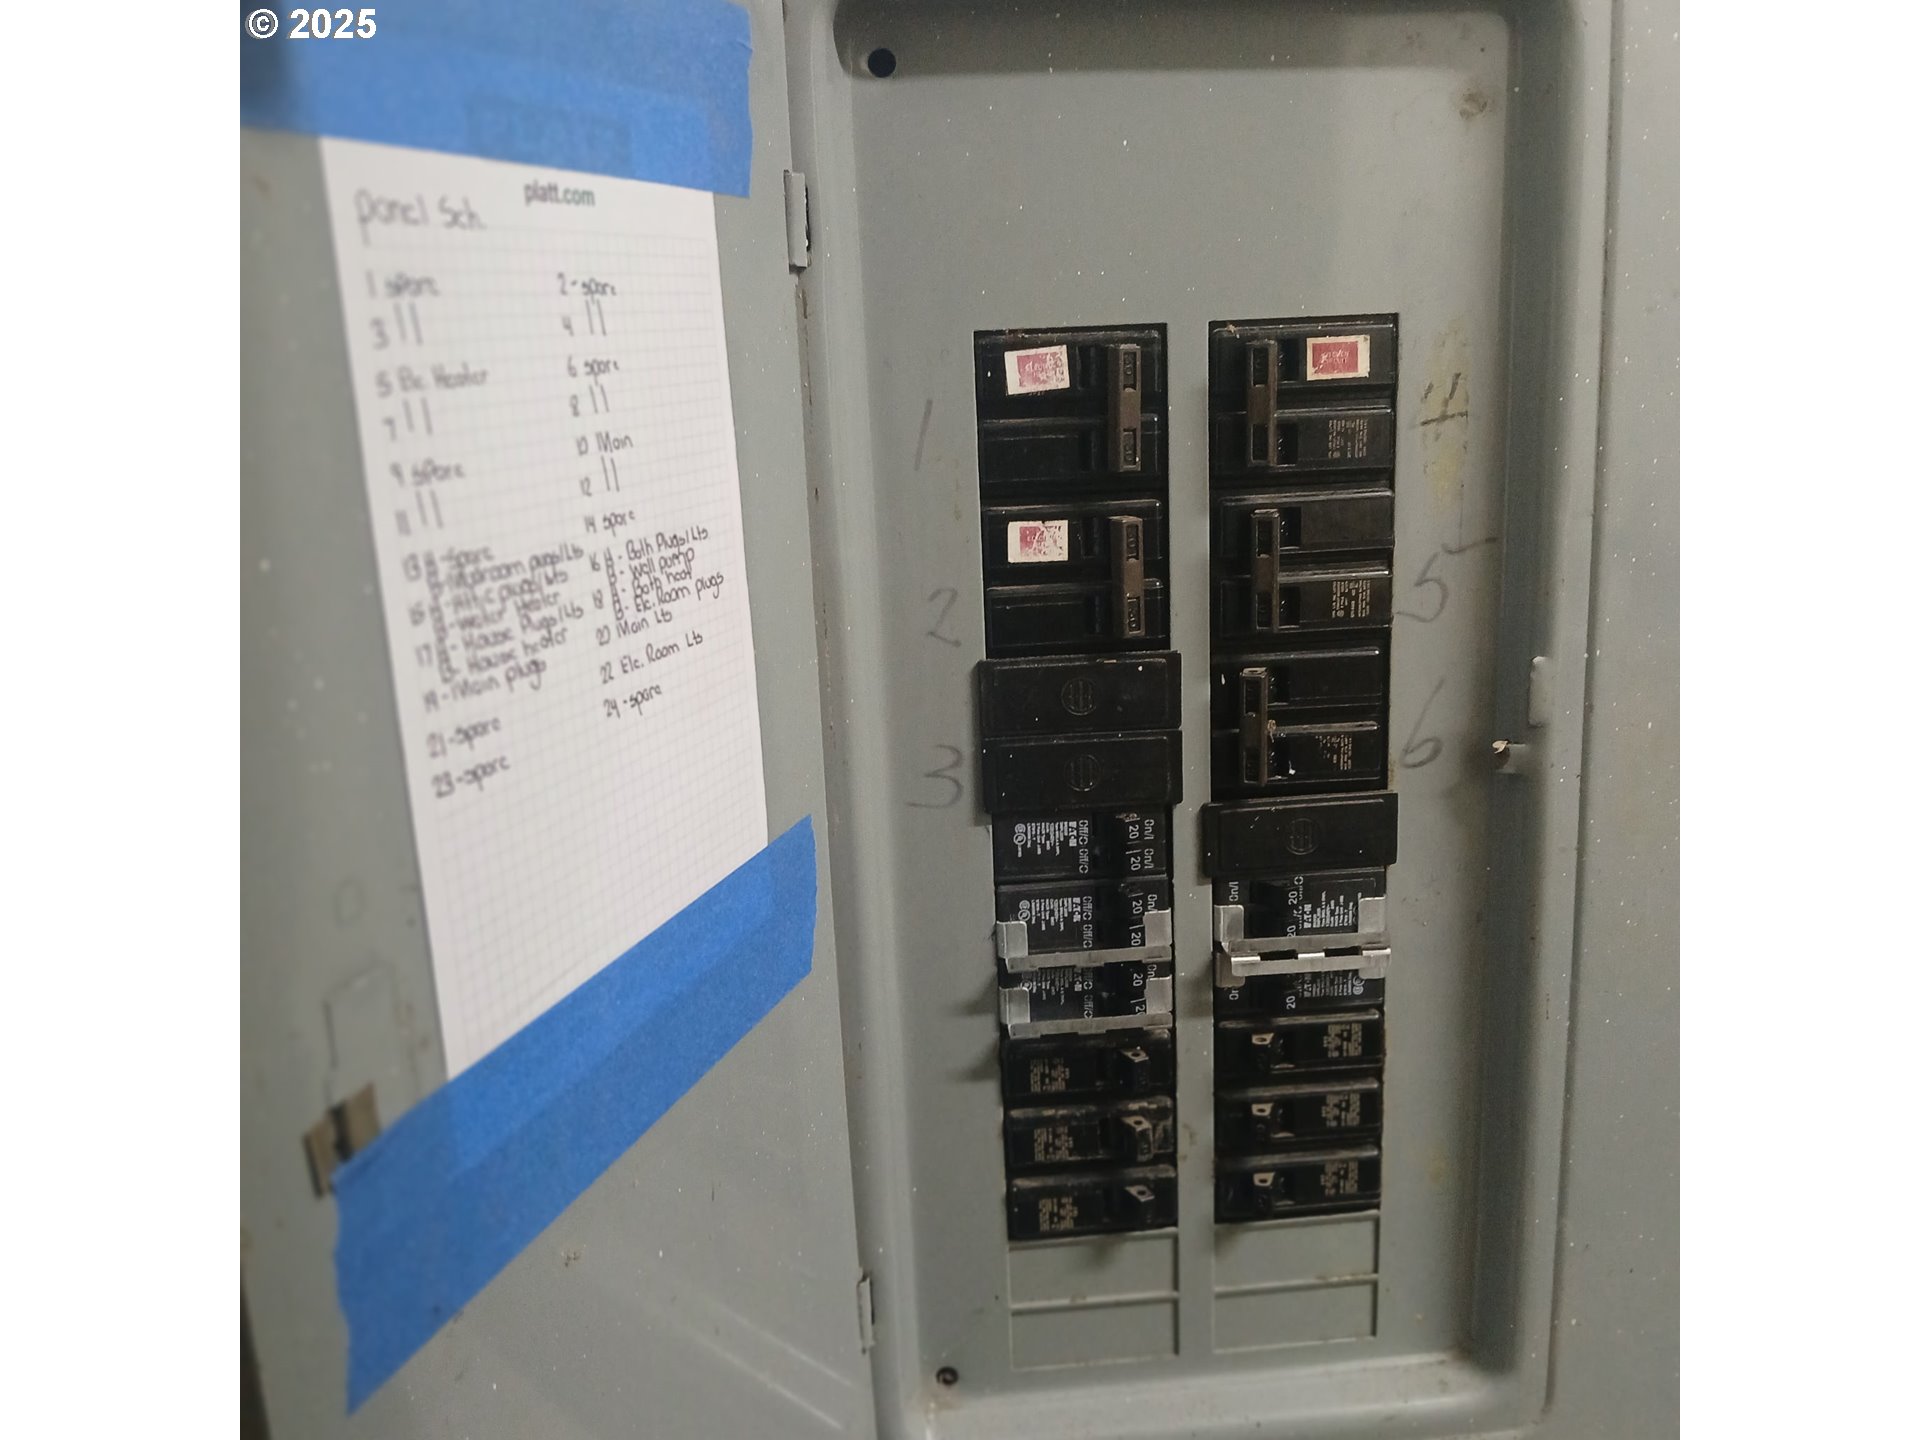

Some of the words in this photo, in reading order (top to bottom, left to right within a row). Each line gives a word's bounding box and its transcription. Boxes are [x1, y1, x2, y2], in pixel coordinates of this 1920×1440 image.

[524, 180, 596, 207] platt.com
[370, 316, 391, 351] 3
[562, 315, 575, 338] 4
[567, 355, 578, 379] 6
[375, 369, 393, 399] 5
[570, 394, 580, 418] 8
[383, 417, 397, 442] 7
[390, 461, 406, 488] 9
[584, 515, 597, 534] 14
[696, 571, 724, 601] plugs
[1397, 536, 1499, 623] 5
[926, 587, 962, 648] 2
[599, 660, 615, 685] 22
[646, 642, 680, 663] Room
[1402, 677, 1444, 769] 6
[906, 744, 965, 809] 3
[1129, 824, 1140, 839] 20
[1130, 856, 1141, 871] 20
[1132, 899, 1143, 915] 20
[1288, 890, 1298, 906] 20
[1131, 932, 1141, 946] 20
[1132, 973, 1143, 987] 20
[1286, 995, 1296, 1010] 20
